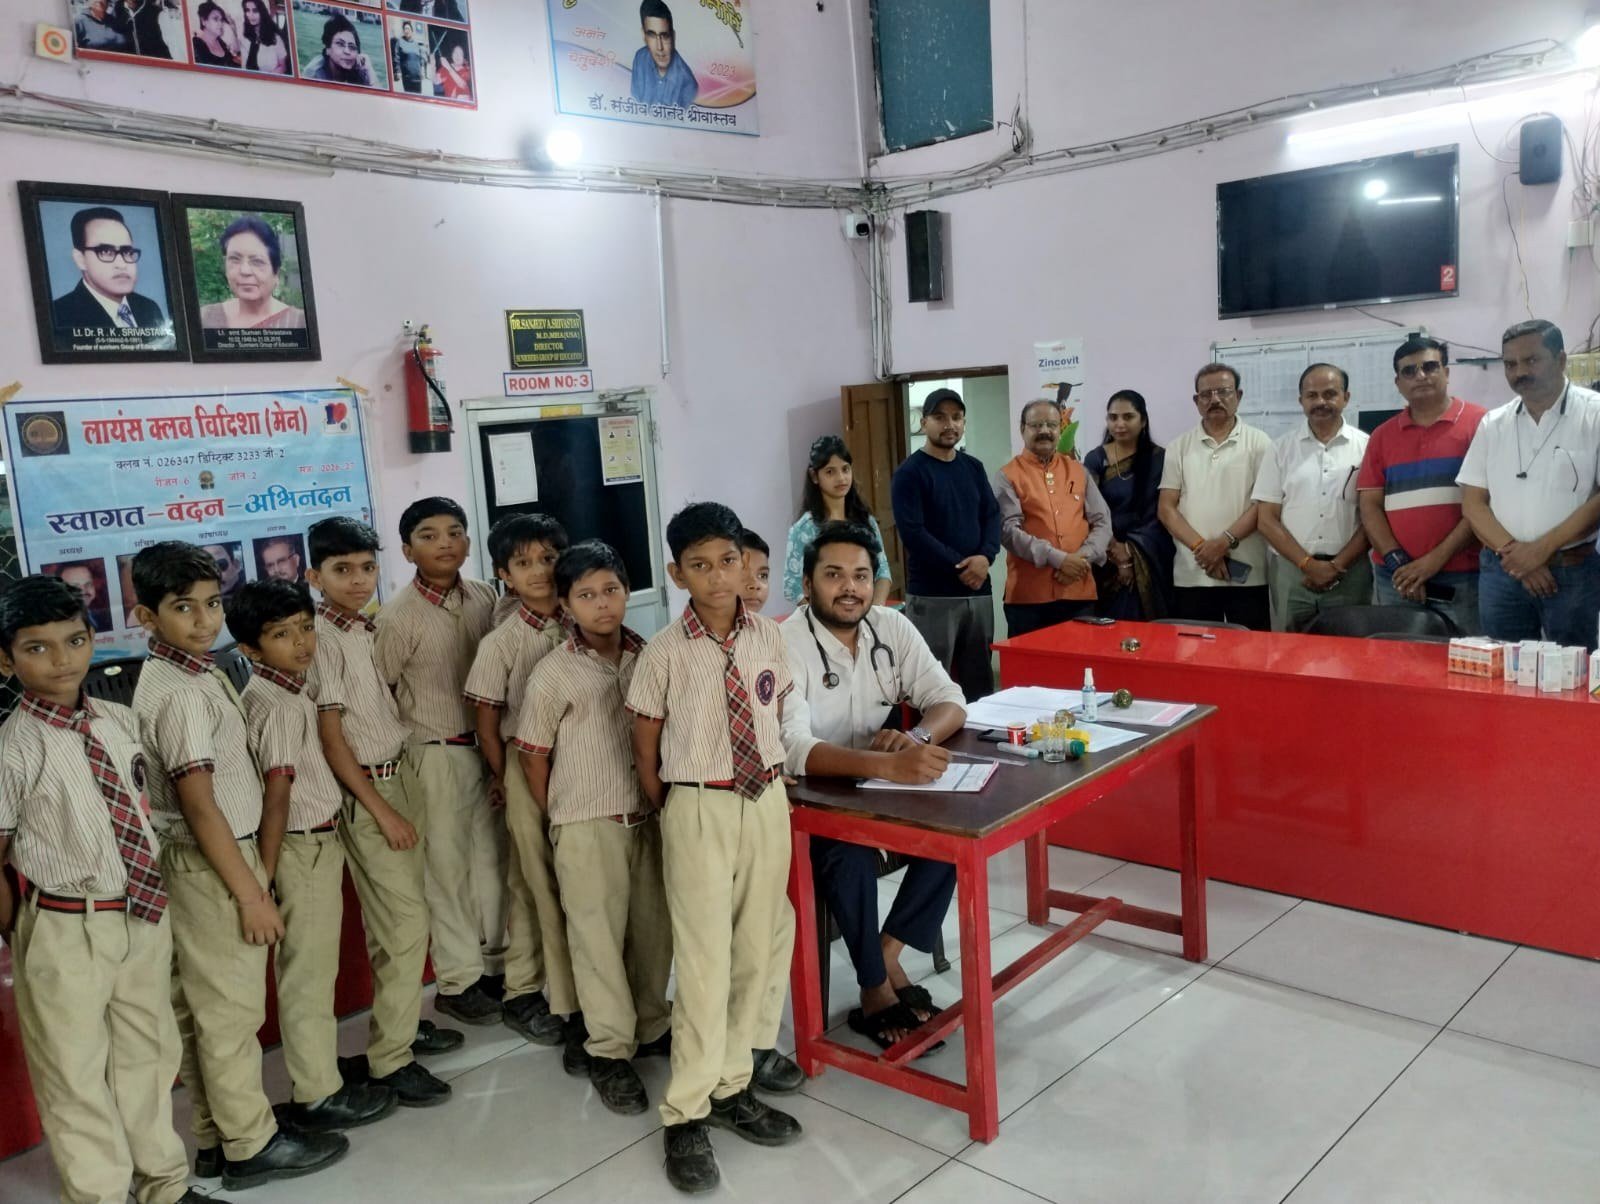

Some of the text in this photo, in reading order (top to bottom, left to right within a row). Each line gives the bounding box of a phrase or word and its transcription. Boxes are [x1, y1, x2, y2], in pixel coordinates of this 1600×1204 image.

[610, 97, 648, 116] संजीव
[652, 103, 684, 121] आनंद
[687, 105, 737, 127] श्रीवास्तव
[85, 328, 96, 337] Dr.
[122, 328, 171, 337] SRIVASTAV
[534, 342, 564, 351] DIRECTOR
[1038, 356, 1080, 368] Zincovit
[509, 376, 551, 391] ROOM
[81, 400, 308, 445] लायंस क्लब विदिशा (मेन)
[114, 459, 140, 470] क्लब
[156, 455, 195, 468] 026347
